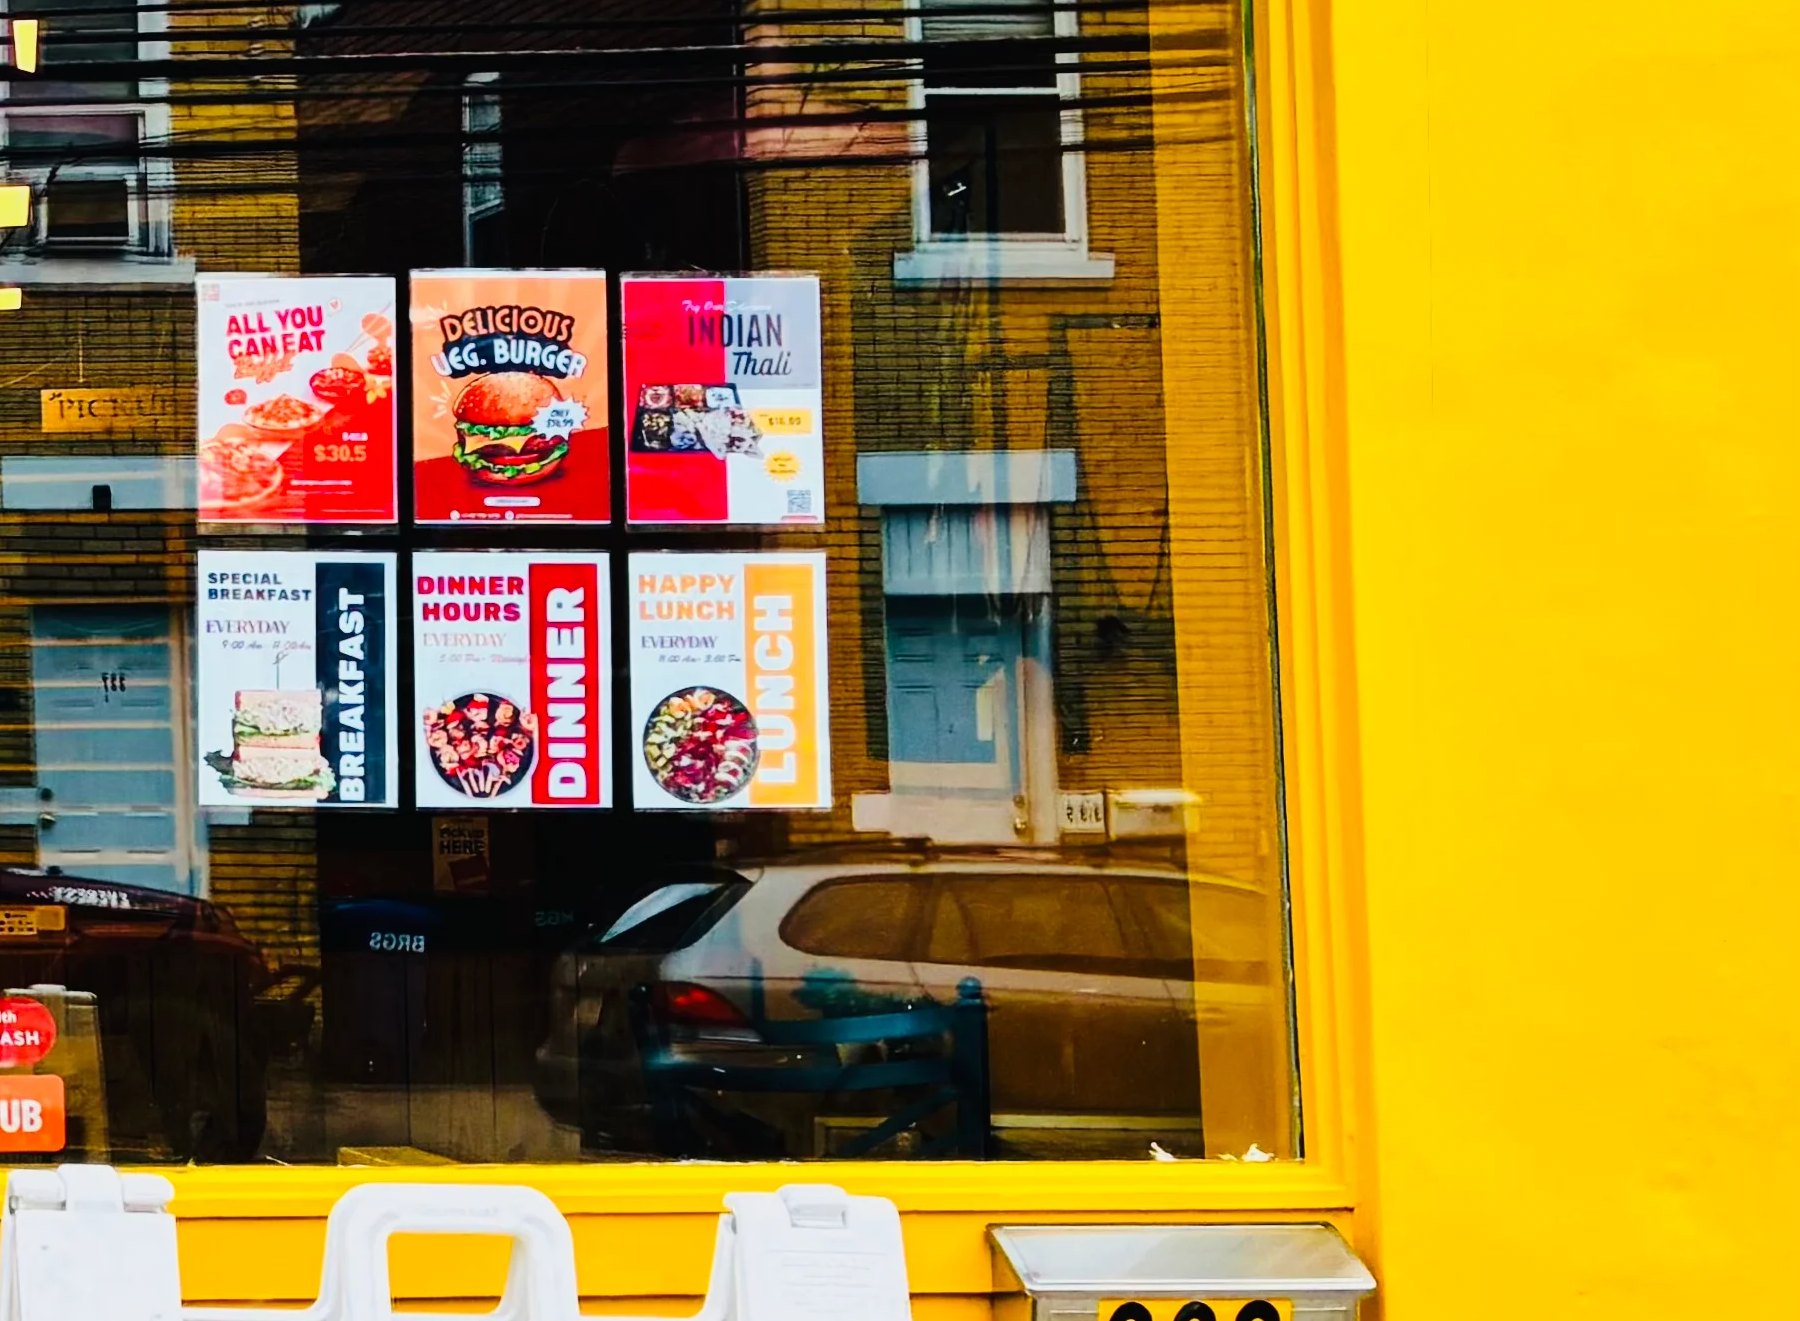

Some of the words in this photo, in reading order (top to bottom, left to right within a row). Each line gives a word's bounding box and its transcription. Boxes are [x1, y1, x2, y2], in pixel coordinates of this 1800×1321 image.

[226, 312, 271, 337] ALL
[275, 305, 324, 330] YOU
[441, 306, 574, 344] DELICIOUS
[688, 313, 783, 347] INDIAN
[227, 336, 277, 361] CAN
[281, 330, 325, 355] EAT
[492, 338, 587, 378] BURGER
[732, 351, 792, 376] Thali
[313, 444, 367, 462] $30.5
[207, 572, 282, 585] SPECIAL
[417, 576, 524, 595] DINNER
[638, 574, 735, 594] HAPPY
[207, 588, 313, 601] BREAKFAST
[422, 602, 521, 621] HOURS
[639, 601, 735, 620] LUNCH
[205, 620, 290, 633] EVERYDAY
[423, 633, 506, 647] EVERYDAY
[641, 635, 718, 649] EVERYDAY
[338, 587, 366, 801] BREAKFAST
[546, 586, 587, 798] DINNER
[753, 594, 796, 784] LUNCH
[439, 840, 485, 855] HERE
